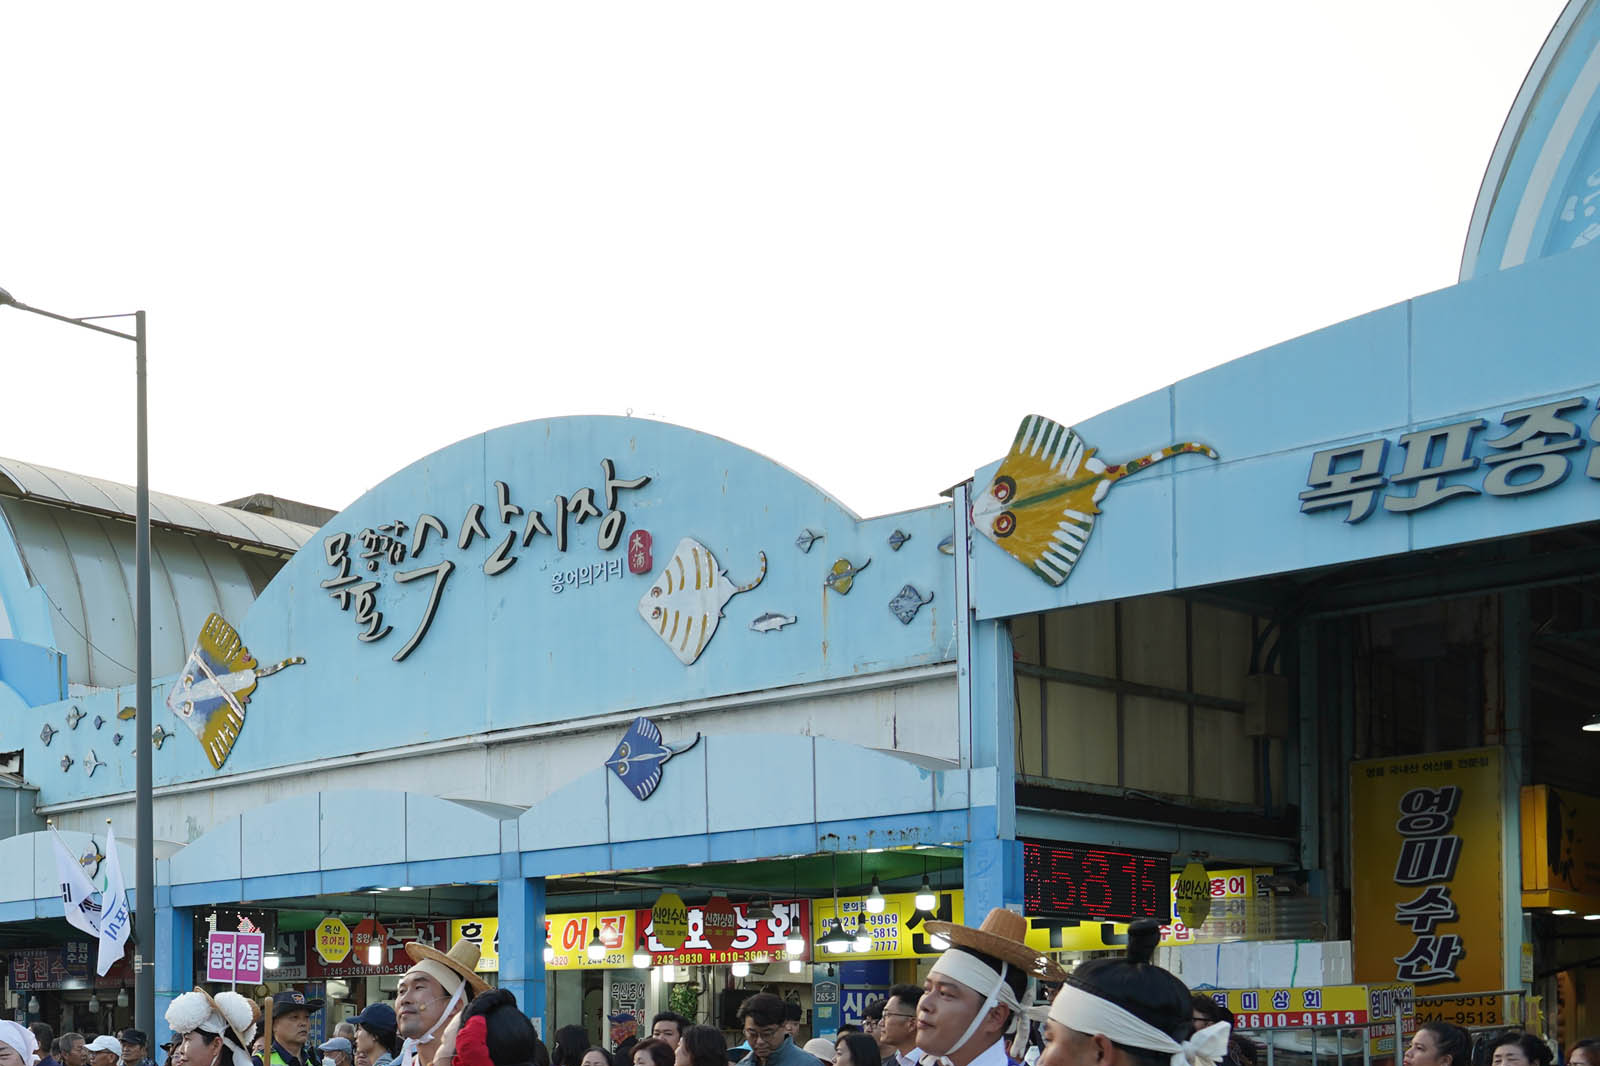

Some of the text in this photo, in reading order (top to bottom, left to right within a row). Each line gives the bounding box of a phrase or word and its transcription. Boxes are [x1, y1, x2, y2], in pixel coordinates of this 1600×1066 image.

[1299, 397, 1600, 523] 목포종
[392, 458, 652, 662] 수산시장
[551, 557, 624, 594] 홍어의거리
[1393, 786, 1462, 984] 영미수산
[104, 896, 128, 941] 포시
[654, 907, 688, 926] 신안수산
[705, 913, 735, 927] 신화상회
[323, 925, 341, 935] 흑산
[355, 932, 384, 944] 중앙산
[320, 935, 345, 946] 홍어집
[211, 942, 260, 972] 용당2동
[817, 992, 836, 1001] 265-3
[1212, 990, 1321, 1011] 영미상회
[1237, 1012, 1355, 1028] 3600-9513
